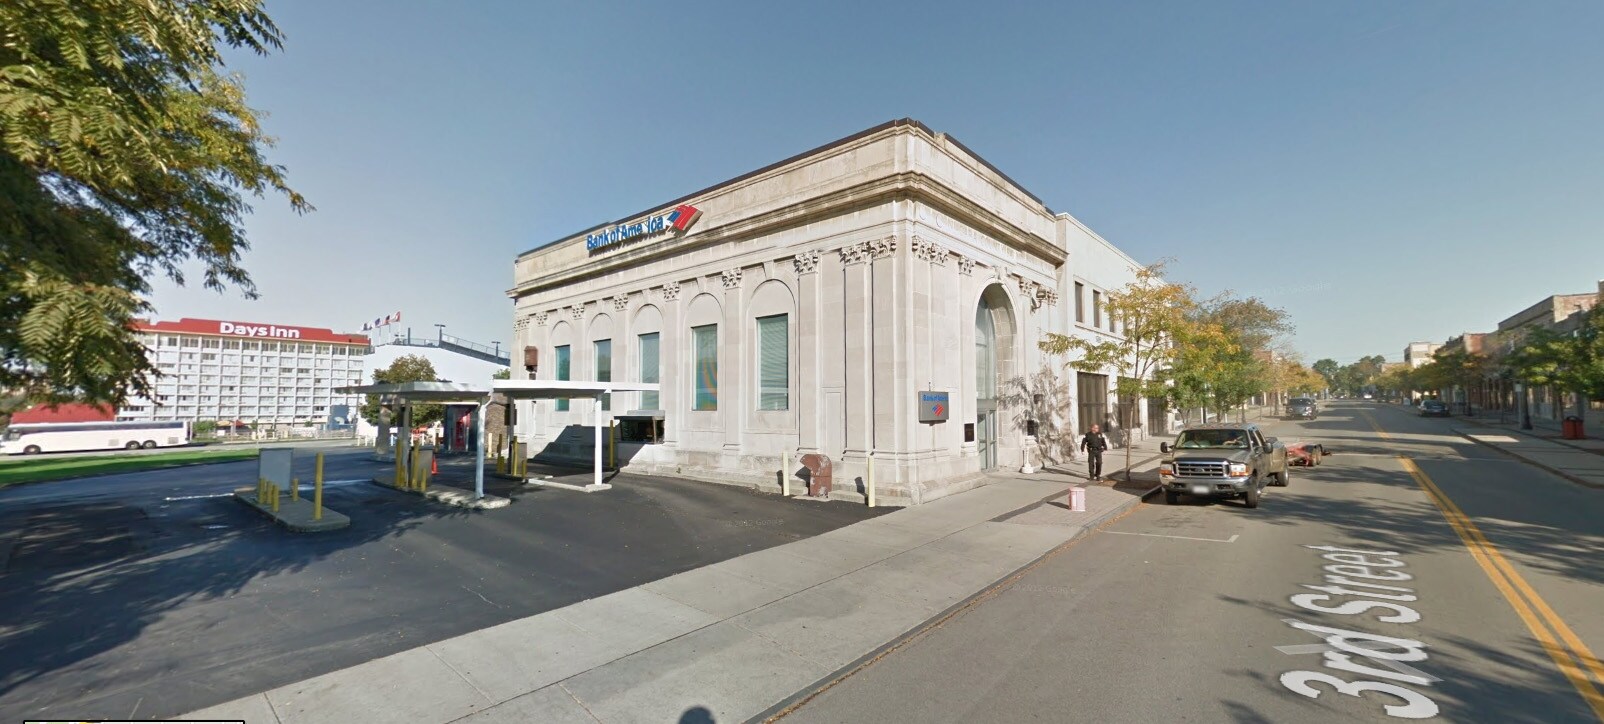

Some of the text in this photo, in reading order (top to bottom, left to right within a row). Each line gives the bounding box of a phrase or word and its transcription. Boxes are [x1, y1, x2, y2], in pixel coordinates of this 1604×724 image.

[587, 230, 610, 250] Bank
[610, 226, 620, 243] of
[220, 322, 300, 338] Days Inn
